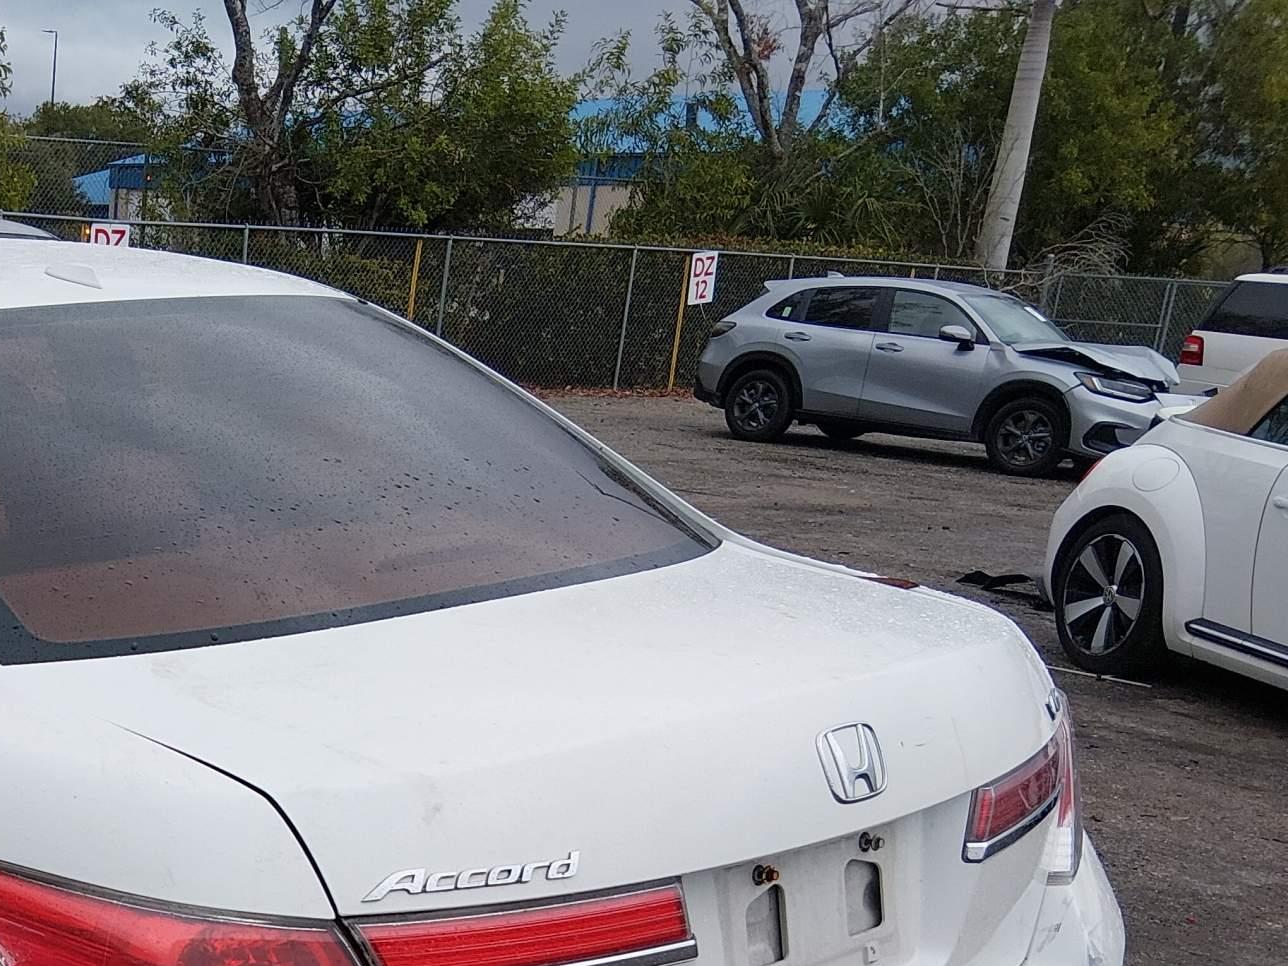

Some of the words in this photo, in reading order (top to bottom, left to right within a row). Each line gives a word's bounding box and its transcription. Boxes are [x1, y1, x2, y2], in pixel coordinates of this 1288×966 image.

[693, 255, 716, 278] DZ
[695, 279, 708, 300] 12
[361, 850, 580, 902] Accord
